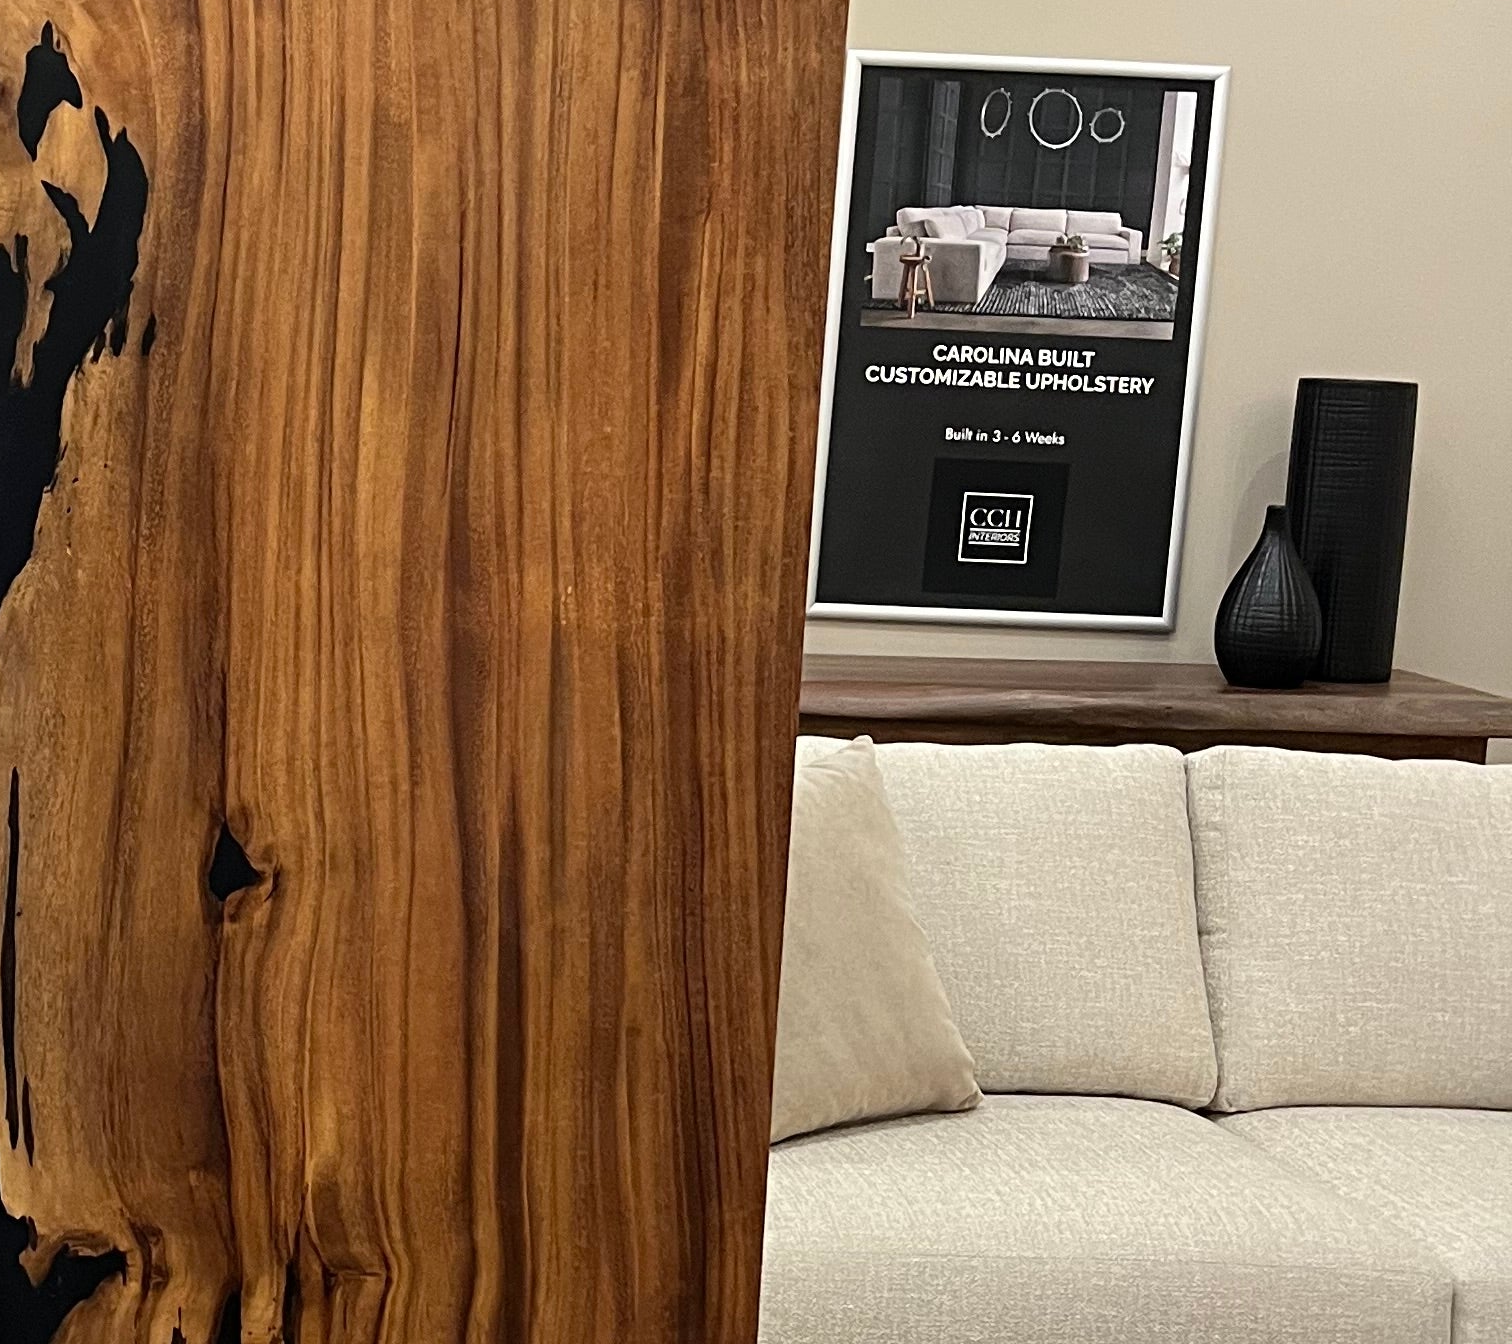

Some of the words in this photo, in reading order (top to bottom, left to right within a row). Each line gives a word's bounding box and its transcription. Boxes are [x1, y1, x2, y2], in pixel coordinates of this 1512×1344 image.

[932, 344, 1034, 367] CAROLINA
[1038, 348, 1096, 369] BUILT
[864, 365, 1021, 390] CUSTOMIZABLE
[1025, 372, 1155, 395] UPHOLSTERY
[945, 427, 973, 442] Built
[976, 428, 988, 443] in
[992, 429, 1001, 444] 3
[1011, 431, 1021, 445] 6
[1025, 431, 1065, 446] Weeks
[968, 531, 1020, 542] INTERIORS
